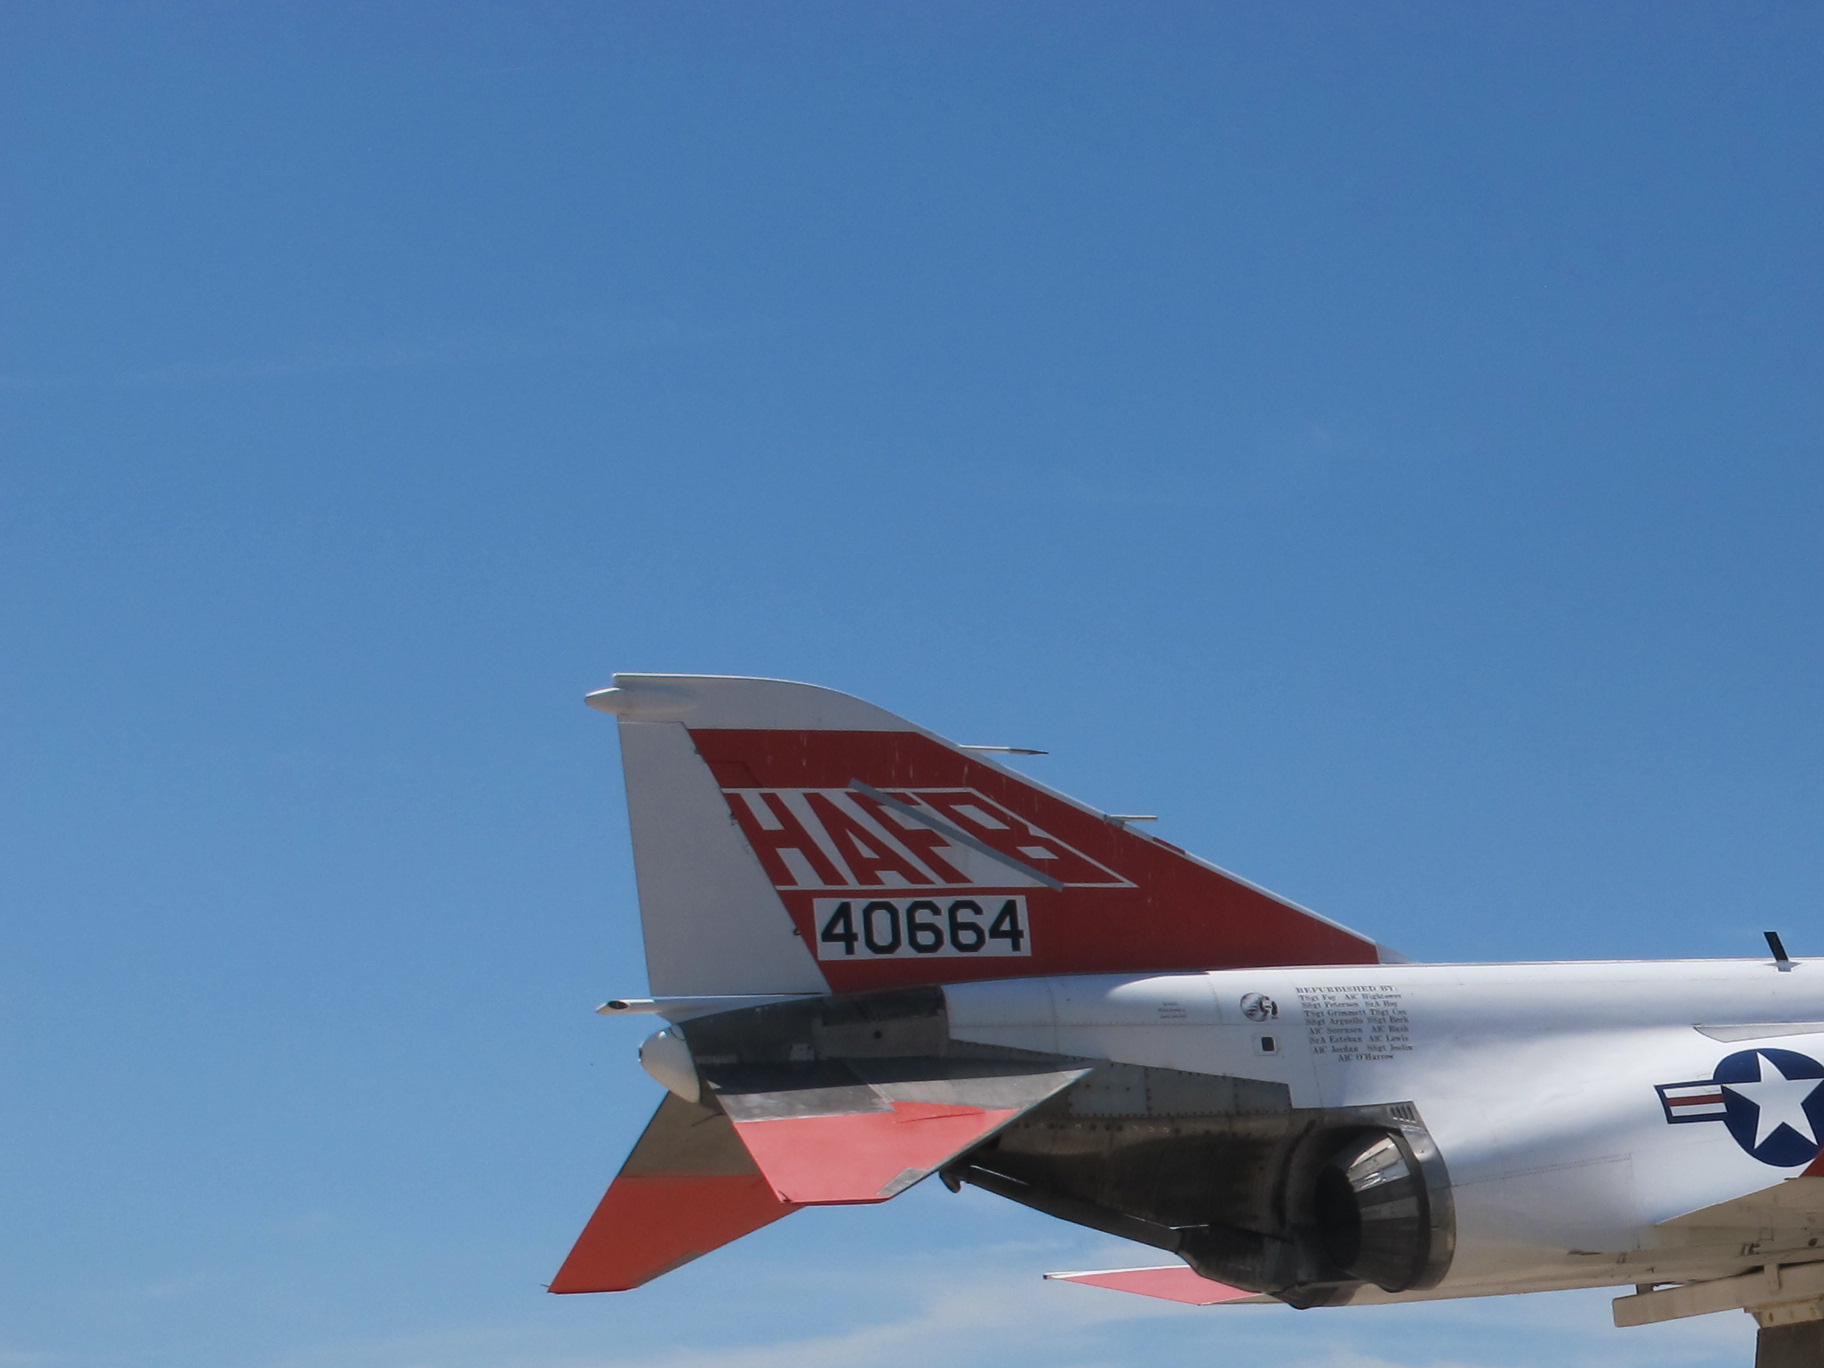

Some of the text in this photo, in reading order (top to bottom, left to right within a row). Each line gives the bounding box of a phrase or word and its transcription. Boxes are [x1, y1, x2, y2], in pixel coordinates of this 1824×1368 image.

[726, 791, 1125, 886] HAFB
[821, 899, 1025, 956] 40664
[1296, 986, 1377, 994] REFURBISHED
